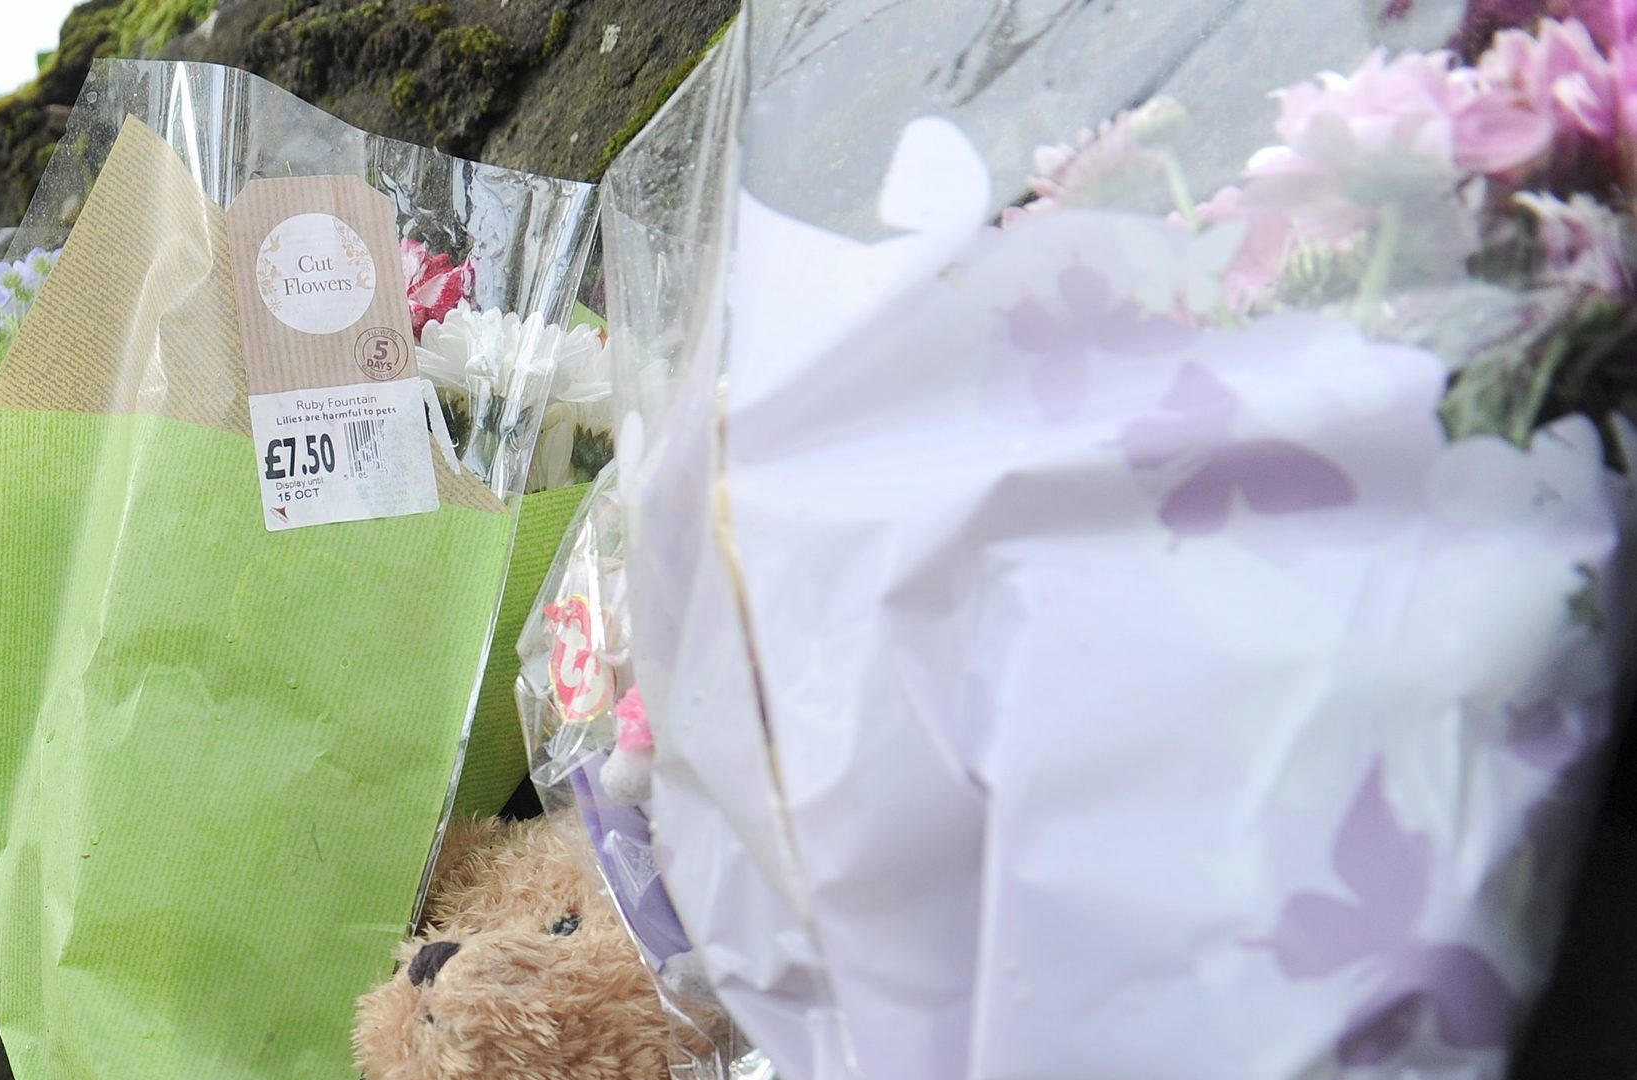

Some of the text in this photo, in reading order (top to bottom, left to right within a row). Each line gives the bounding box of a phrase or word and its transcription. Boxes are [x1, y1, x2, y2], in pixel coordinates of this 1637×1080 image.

[298, 255, 334, 273] Cut
[283, 278, 353, 296] Flowers
[373, 340, 389, 360] 5
[366, 358, 393, 371] DAYS
[296, 395, 378, 411] Ruby Fountain
[276, 407, 397, 426] Lilies are harmful to pets
[265, 433, 336, 480] £7.50
[276, 477, 324, 490] Display until
[295, 488, 320, 499] OCT
[557, 619, 605, 712] ty
